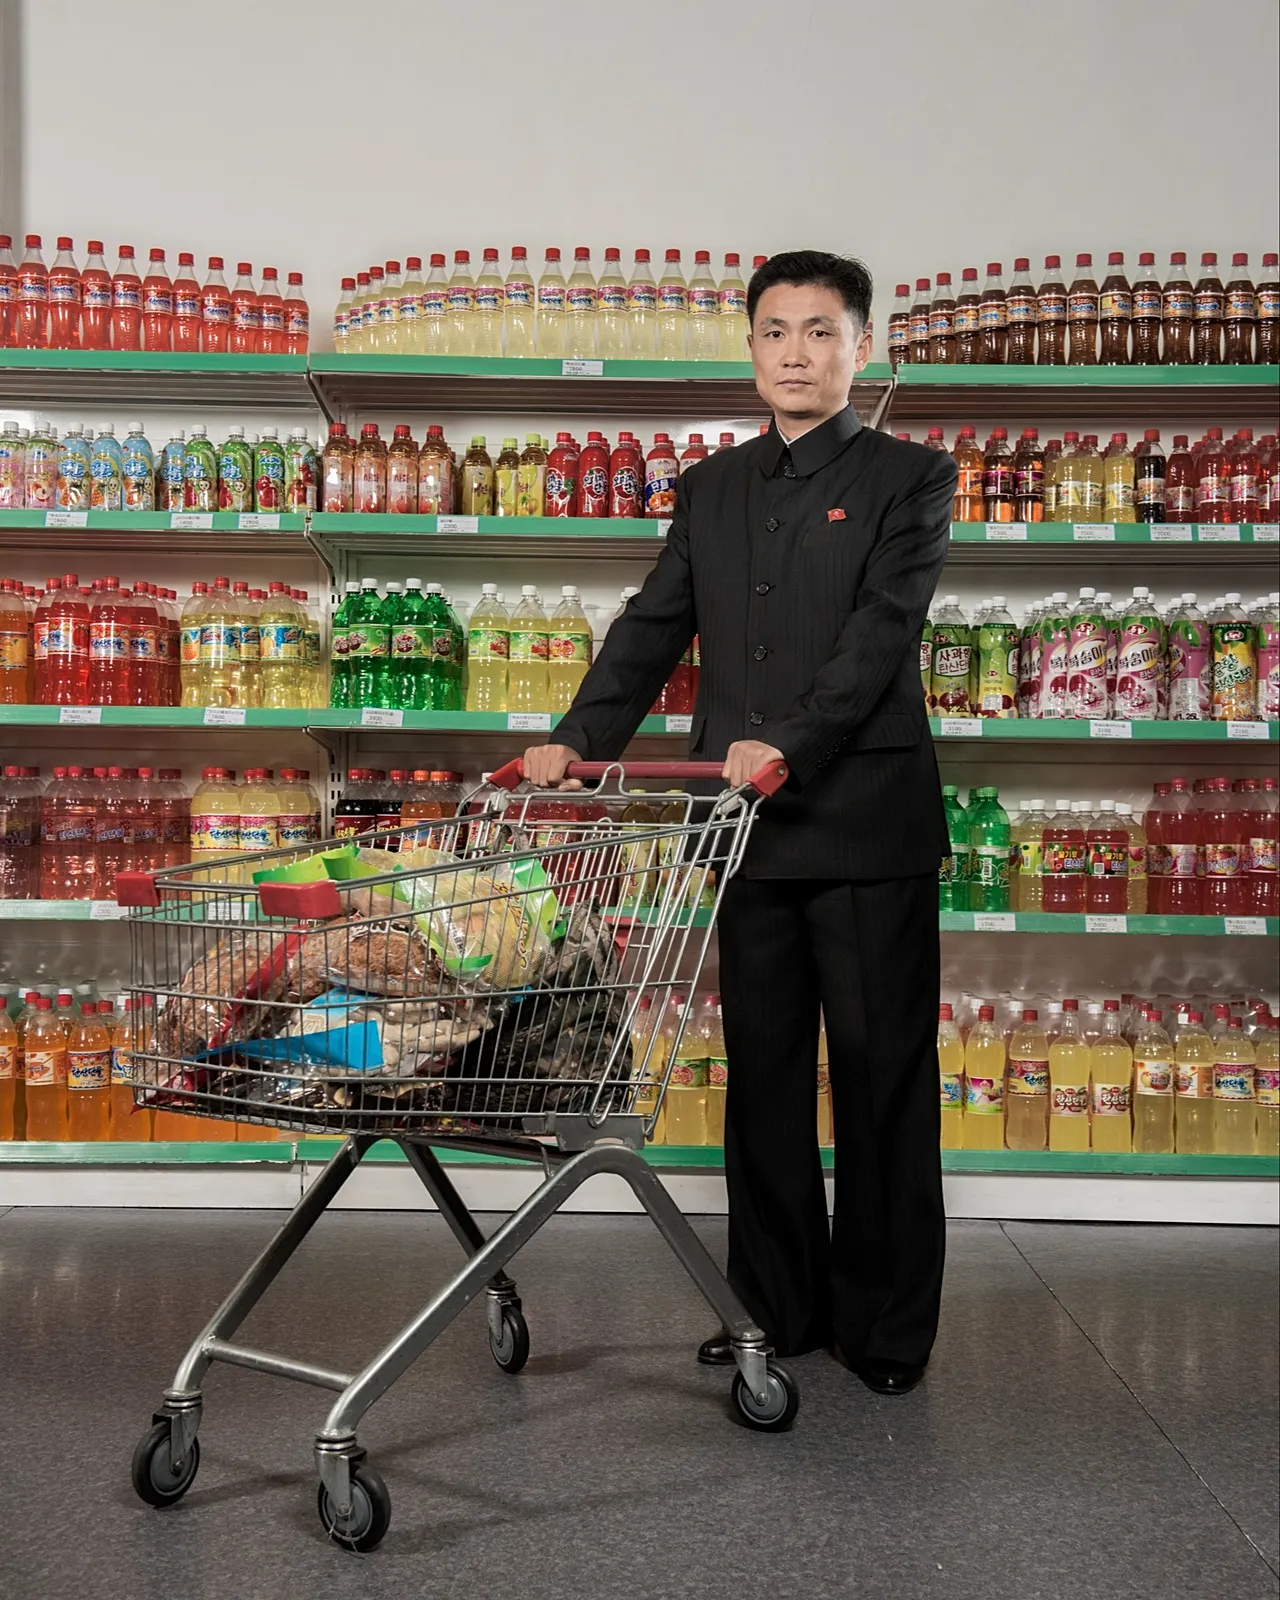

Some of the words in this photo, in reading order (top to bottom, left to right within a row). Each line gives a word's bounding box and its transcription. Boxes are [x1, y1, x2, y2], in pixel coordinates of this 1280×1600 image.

[91, 638, 125, 650] 탄산단물
[939, 646, 970, 662] 사과향
[71, 1066, 104, 1078] 탄산단물
